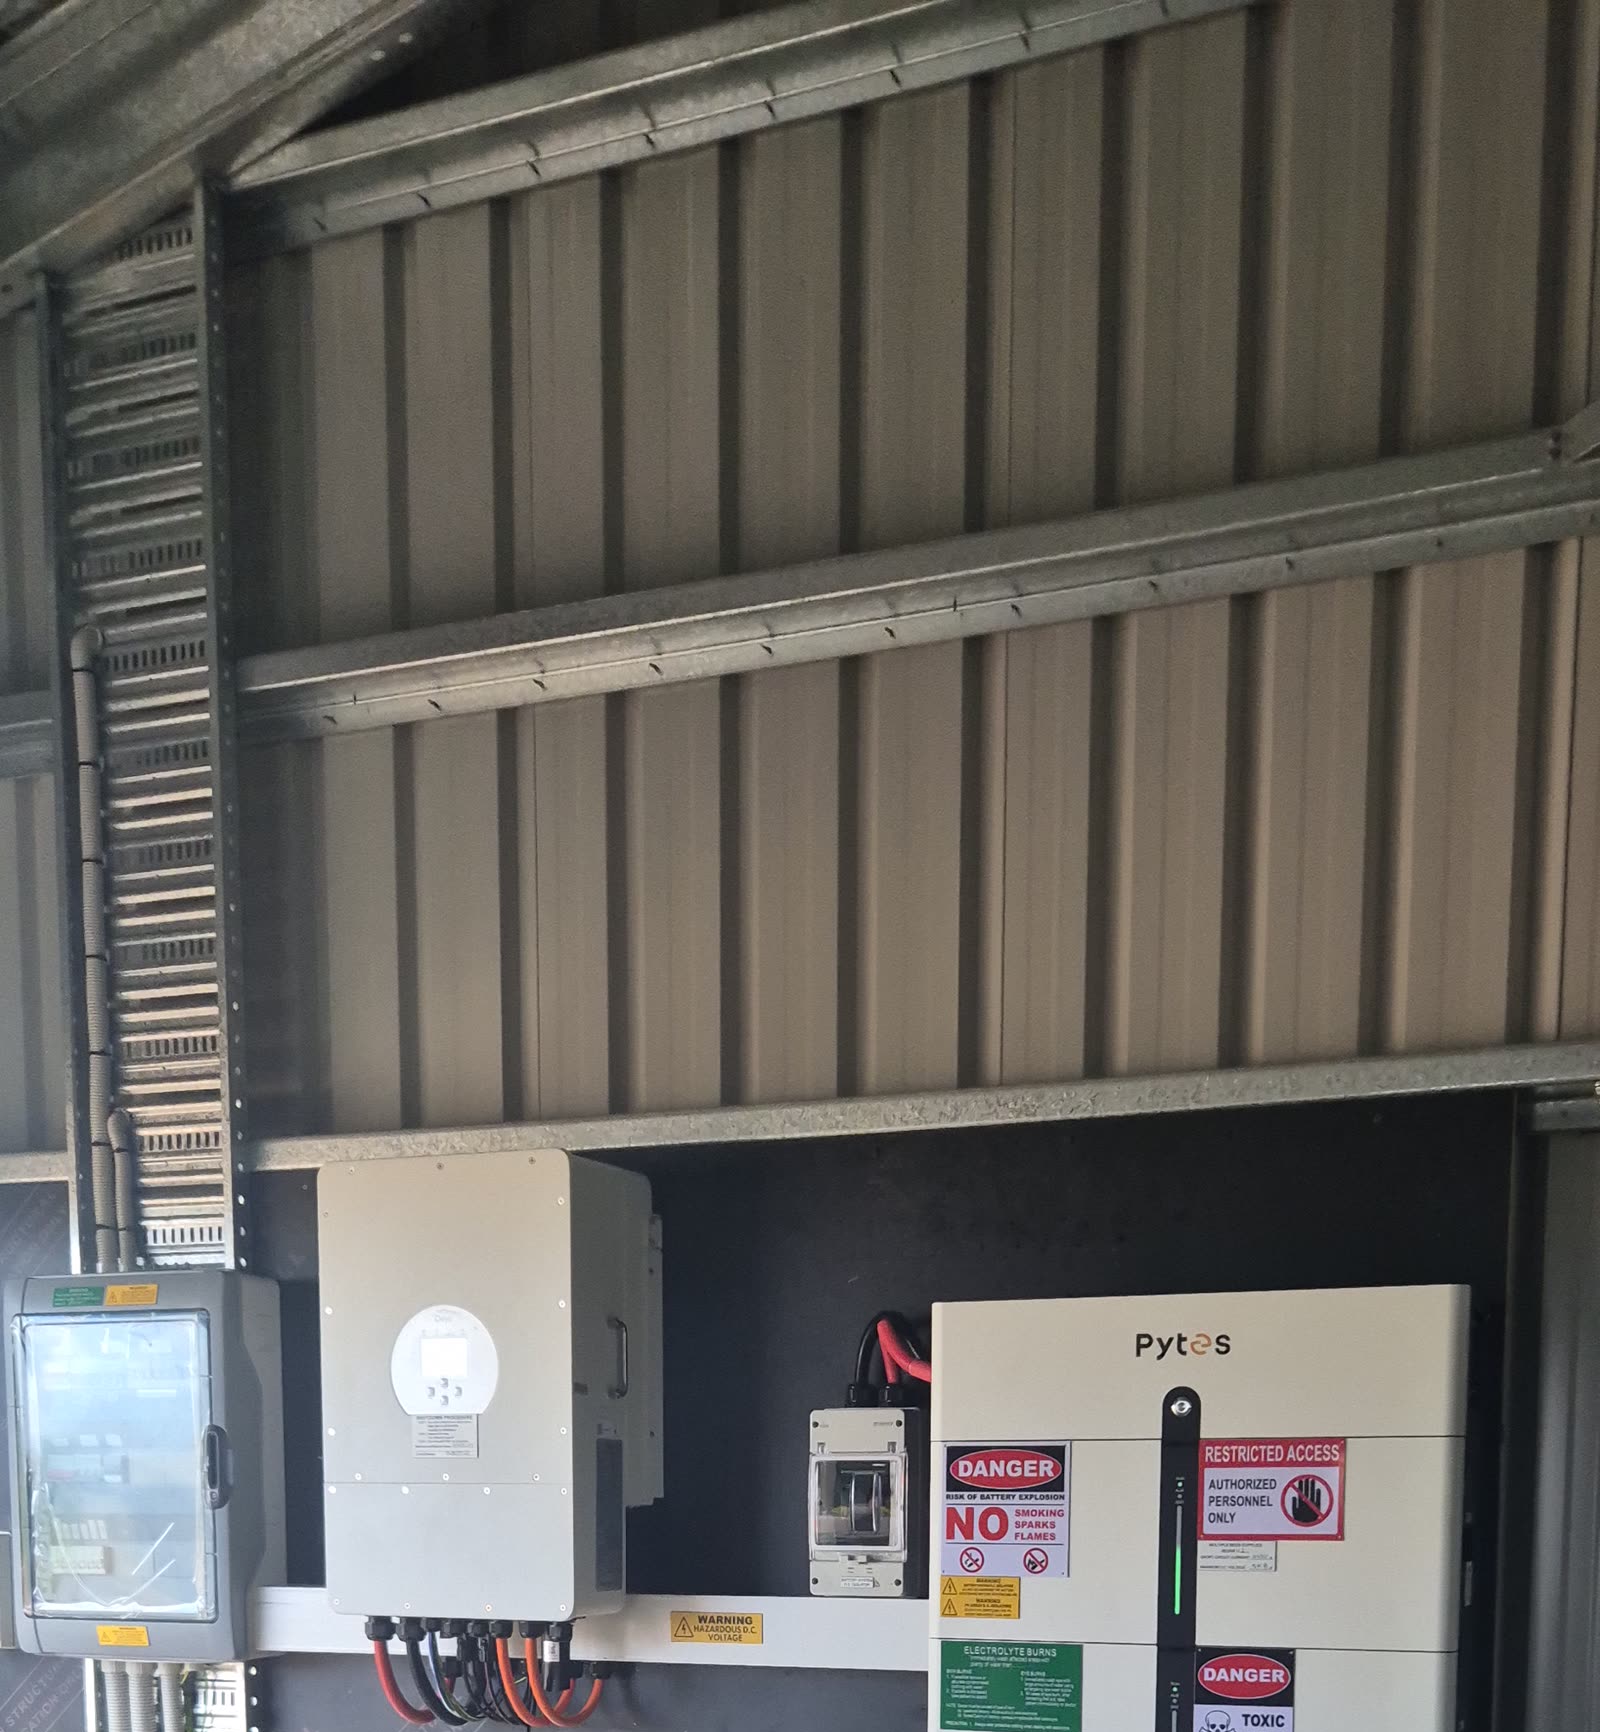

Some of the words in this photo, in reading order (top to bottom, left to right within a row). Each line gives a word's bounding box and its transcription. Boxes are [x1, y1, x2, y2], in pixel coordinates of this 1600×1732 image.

[1205, 1446, 1284, 1463] RESTRICTED
[1286, 1444, 1340, 1462] ACCESS
[958, 1460, 1055, 1477] DANGER
[1208, 1479, 1277, 1490] AUTHORIZED
[1208, 1496, 1273, 1507] PERSONNEL
[1014, 1509, 1065, 1518] SMOKING
[1208, 1512, 1236, 1523] ONLY
[945, 1506, 1009, 1541] NO
[1014, 1521, 1056, 1529] SPARKS
[1014, 1532, 1056, 1541] FLAMES
[697, 1615, 753, 1625] WARNING
[693, 1625, 741, 1633] HAZARDOUS
[708, 1634, 743, 1642] VOLTAGE
[963, 1646, 1025, 1656] ELECTROLYTE
[1027, 1647, 1057, 1657] BURNS
[1203, 1667, 1285, 1683] DANGER
[1242, 1714, 1285, 1728] TOXIC
